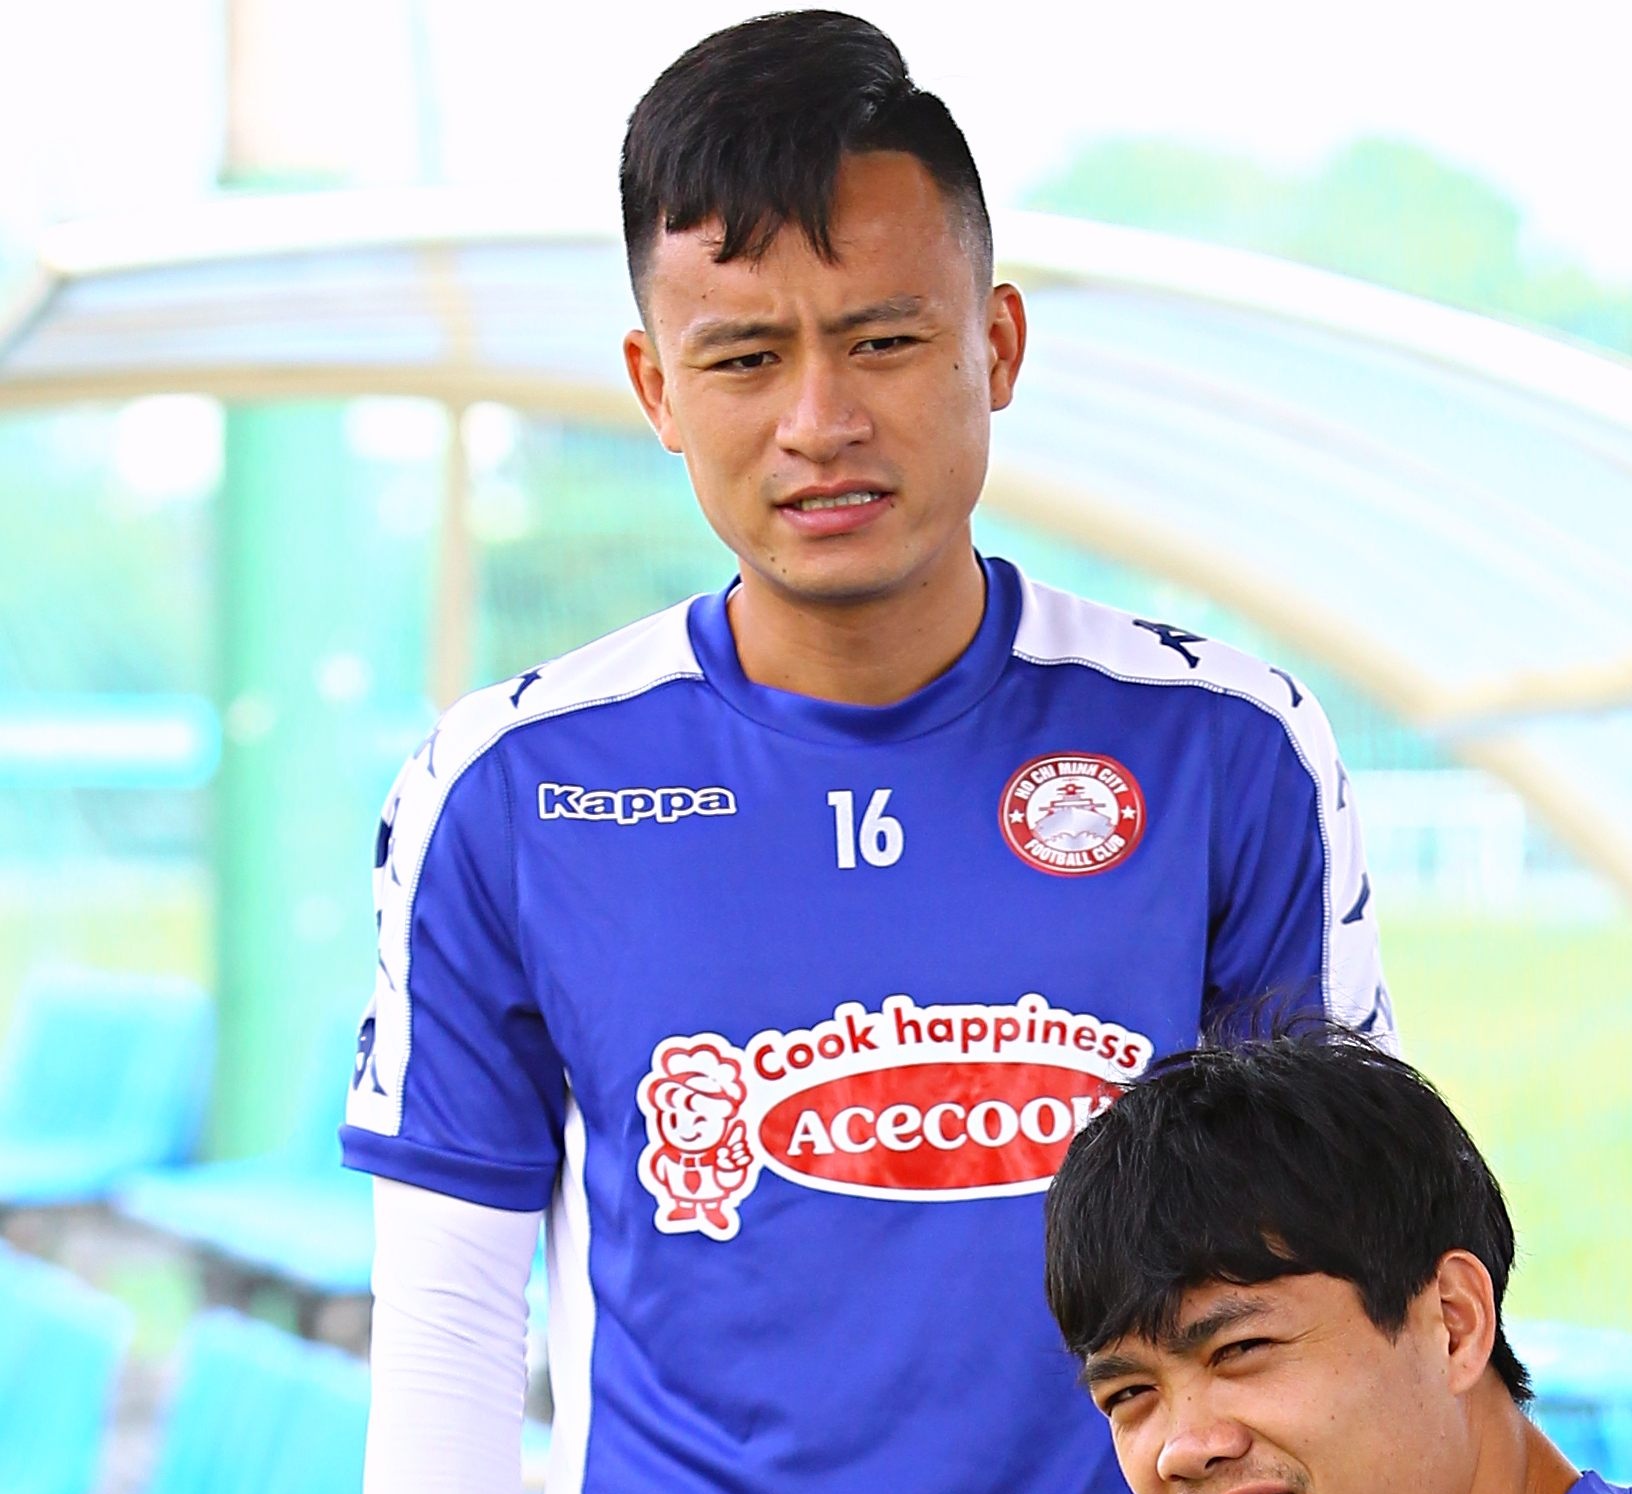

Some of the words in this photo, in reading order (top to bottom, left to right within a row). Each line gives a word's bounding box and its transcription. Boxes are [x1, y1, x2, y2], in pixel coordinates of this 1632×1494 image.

[1014, 779, 1034, 800] HO
[1030, 764, 1057, 784] CHI
[1057, 762, 1100, 776] MINH
[1098, 768, 1129, 794] CITY
[538, 783, 737, 824] Kappa
[827, 788, 904, 868] 16
[1024, 838, 1093, 866] FOOTBALL
[1092, 834, 1126, 861] CLUB
[754, 1014, 878, 1080] Cook
[893, 1005, 1142, 1069] happiness
